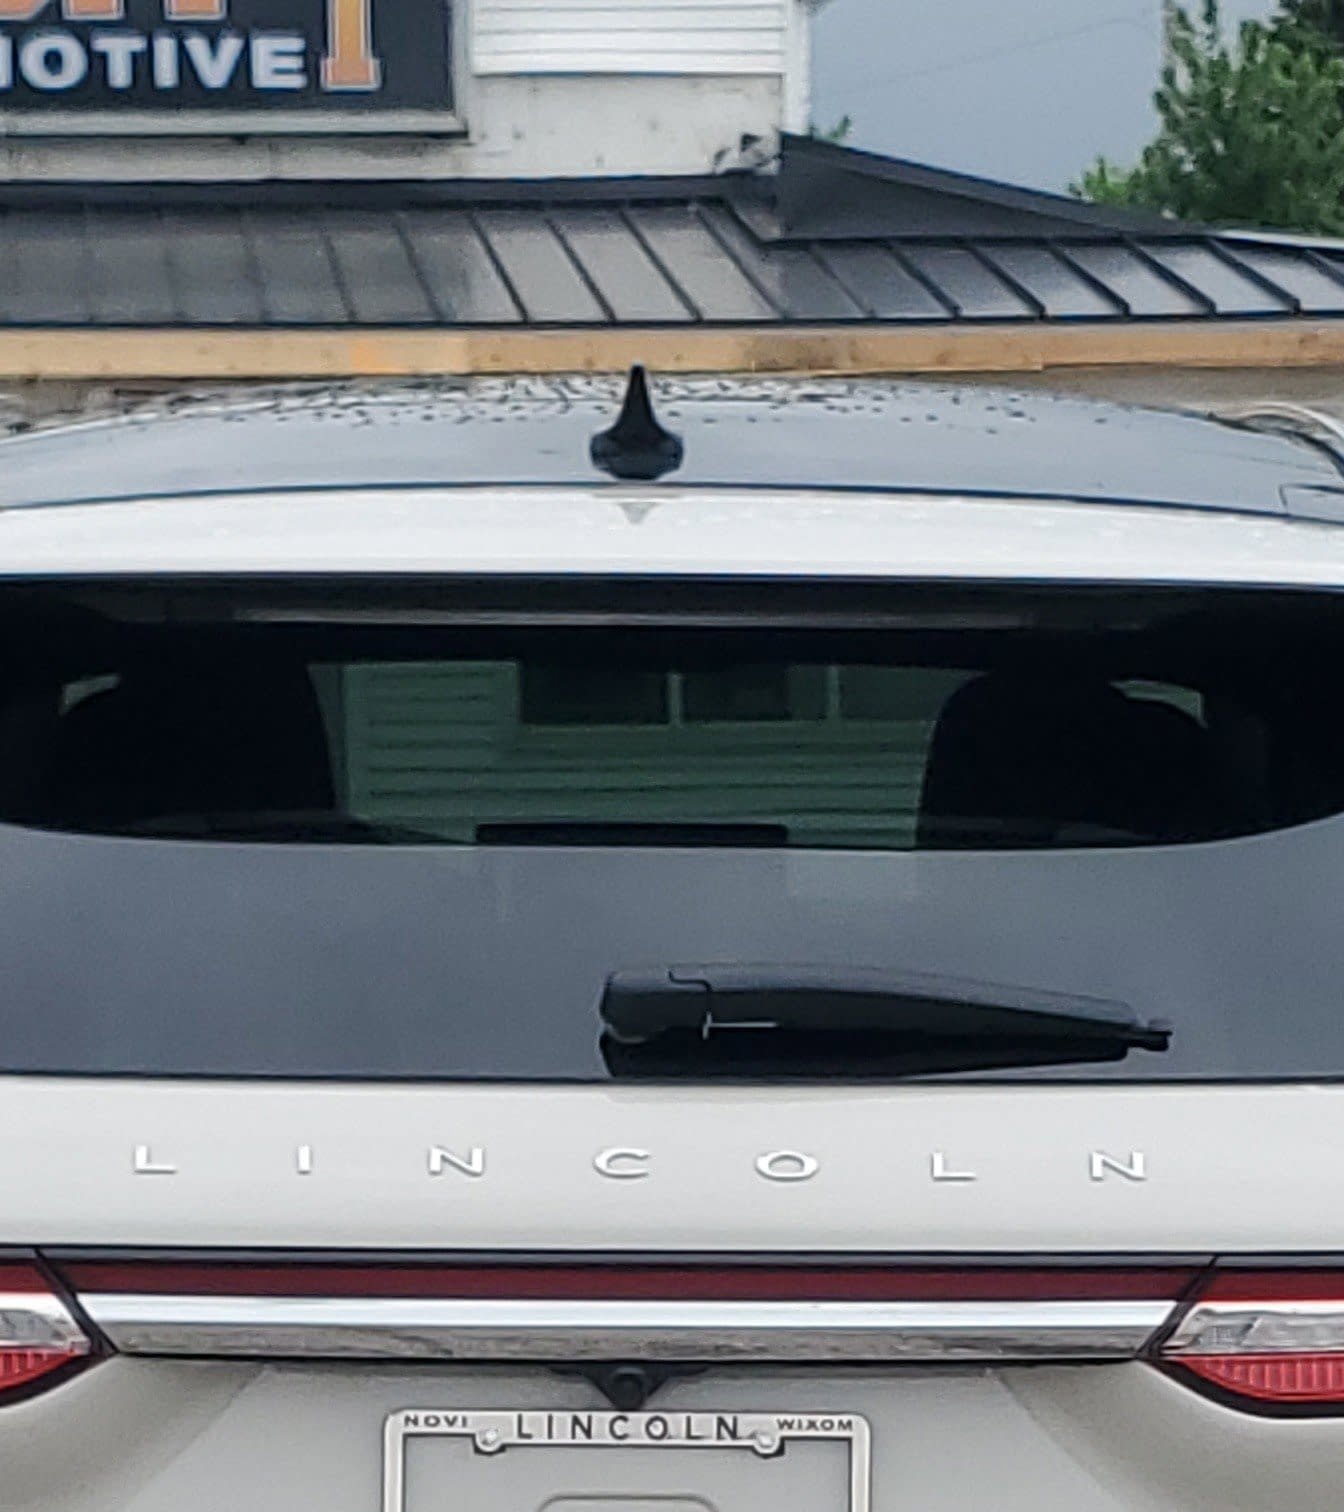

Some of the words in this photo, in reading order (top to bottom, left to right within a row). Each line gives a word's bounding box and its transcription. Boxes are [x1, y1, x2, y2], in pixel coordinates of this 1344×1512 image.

[133, 1145, 1147, 1182] LINCOLN
[404, 1415, 468, 1429] NOVI
[517, 1413, 740, 1441] LINCOLN
[777, 1417, 854, 1432] WIXOM
